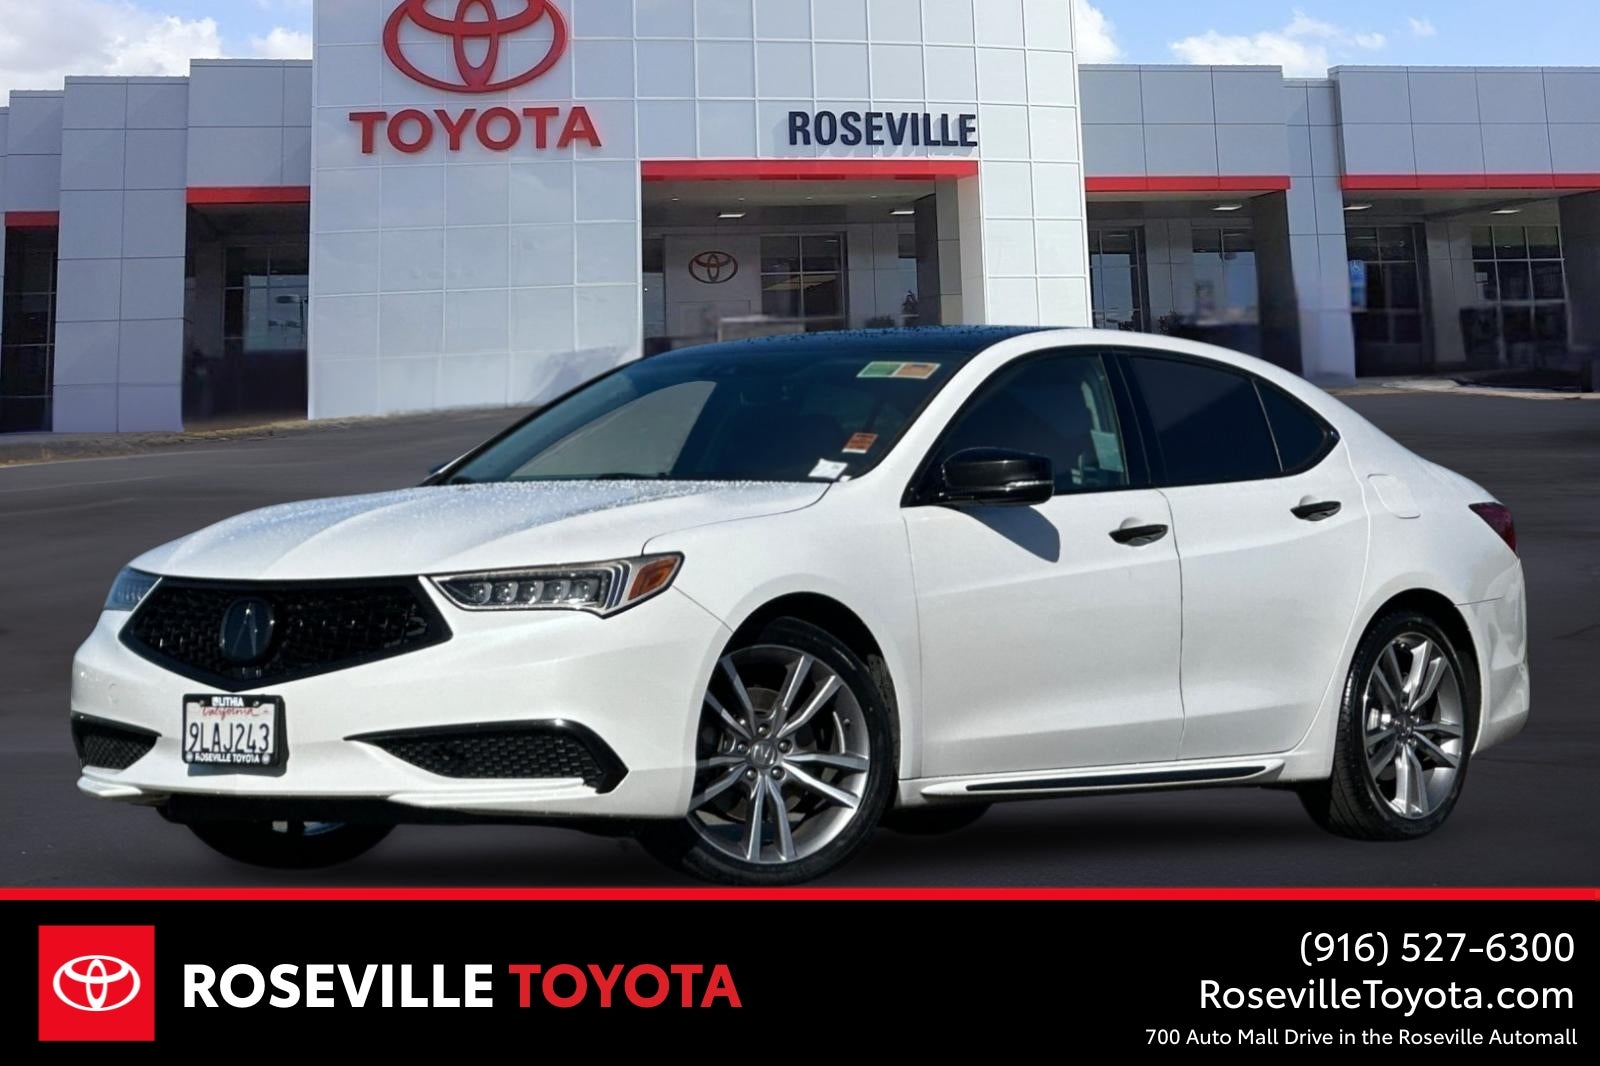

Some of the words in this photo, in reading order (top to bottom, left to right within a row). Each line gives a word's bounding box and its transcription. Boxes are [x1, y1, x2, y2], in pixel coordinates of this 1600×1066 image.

[349, 106, 602, 154] TOYOTA
[788, 110, 978, 147] ROSEVILLE
[189, 722, 270, 753] 9LAJ243
[194, 752, 231, 763] ROSEVILLE
[232, 753, 260, 764] TOYOTA
